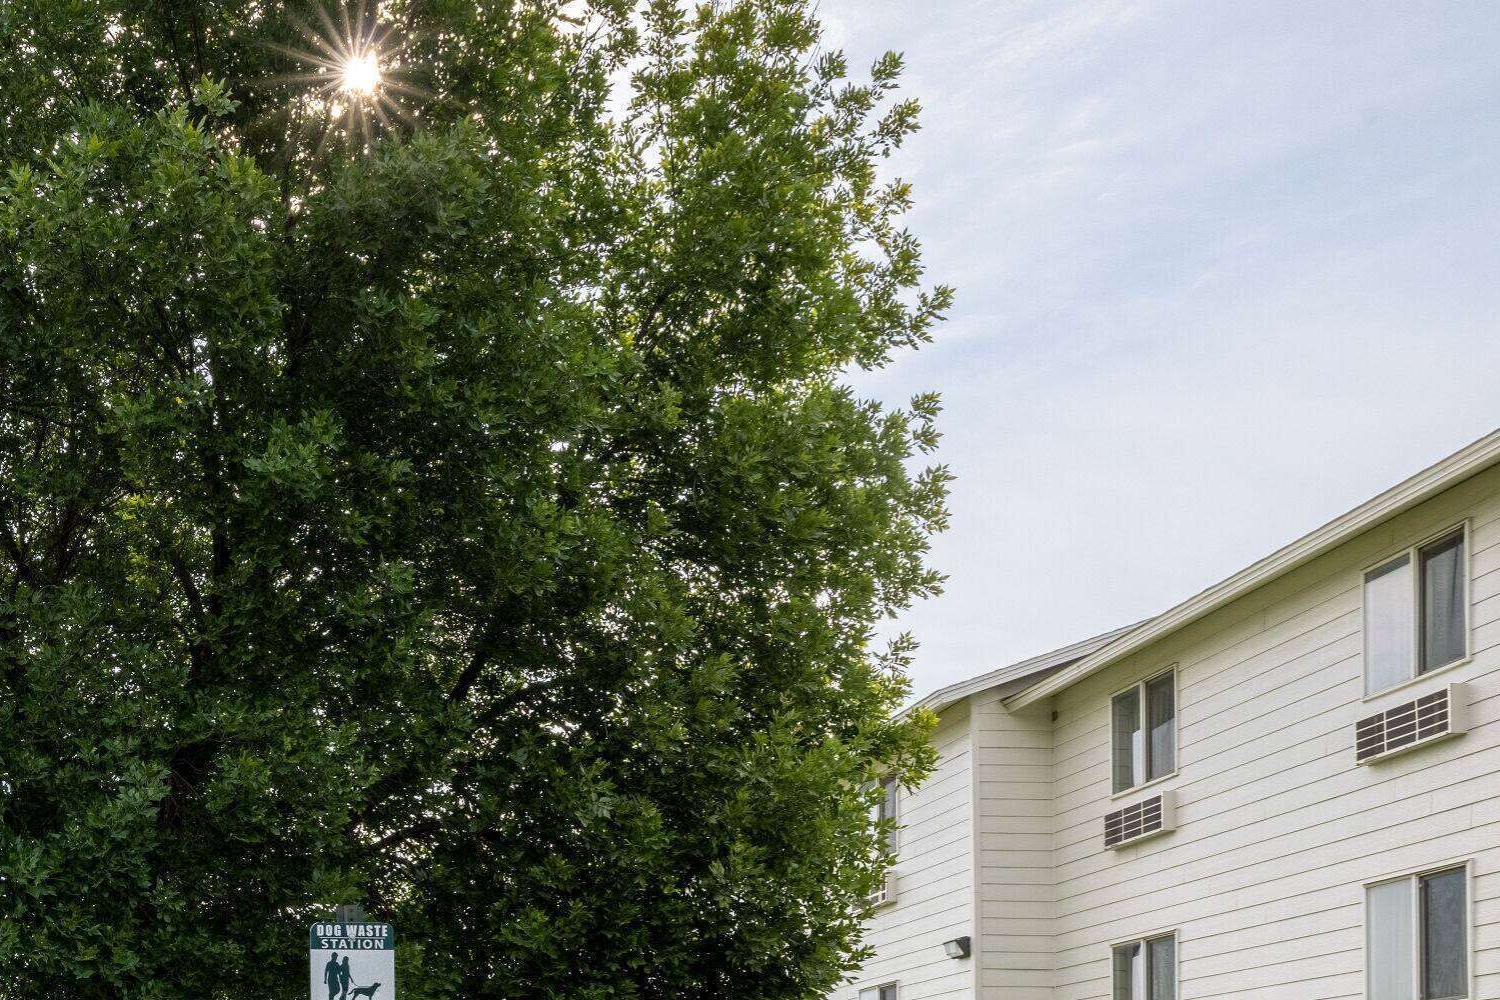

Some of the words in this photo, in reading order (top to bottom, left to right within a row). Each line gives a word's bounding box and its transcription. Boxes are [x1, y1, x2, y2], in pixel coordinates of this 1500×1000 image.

[316, 924, 342, 937] DOG
[346, 924, 388, 937] WASTE
[321, 939, 384, 950] STATION
